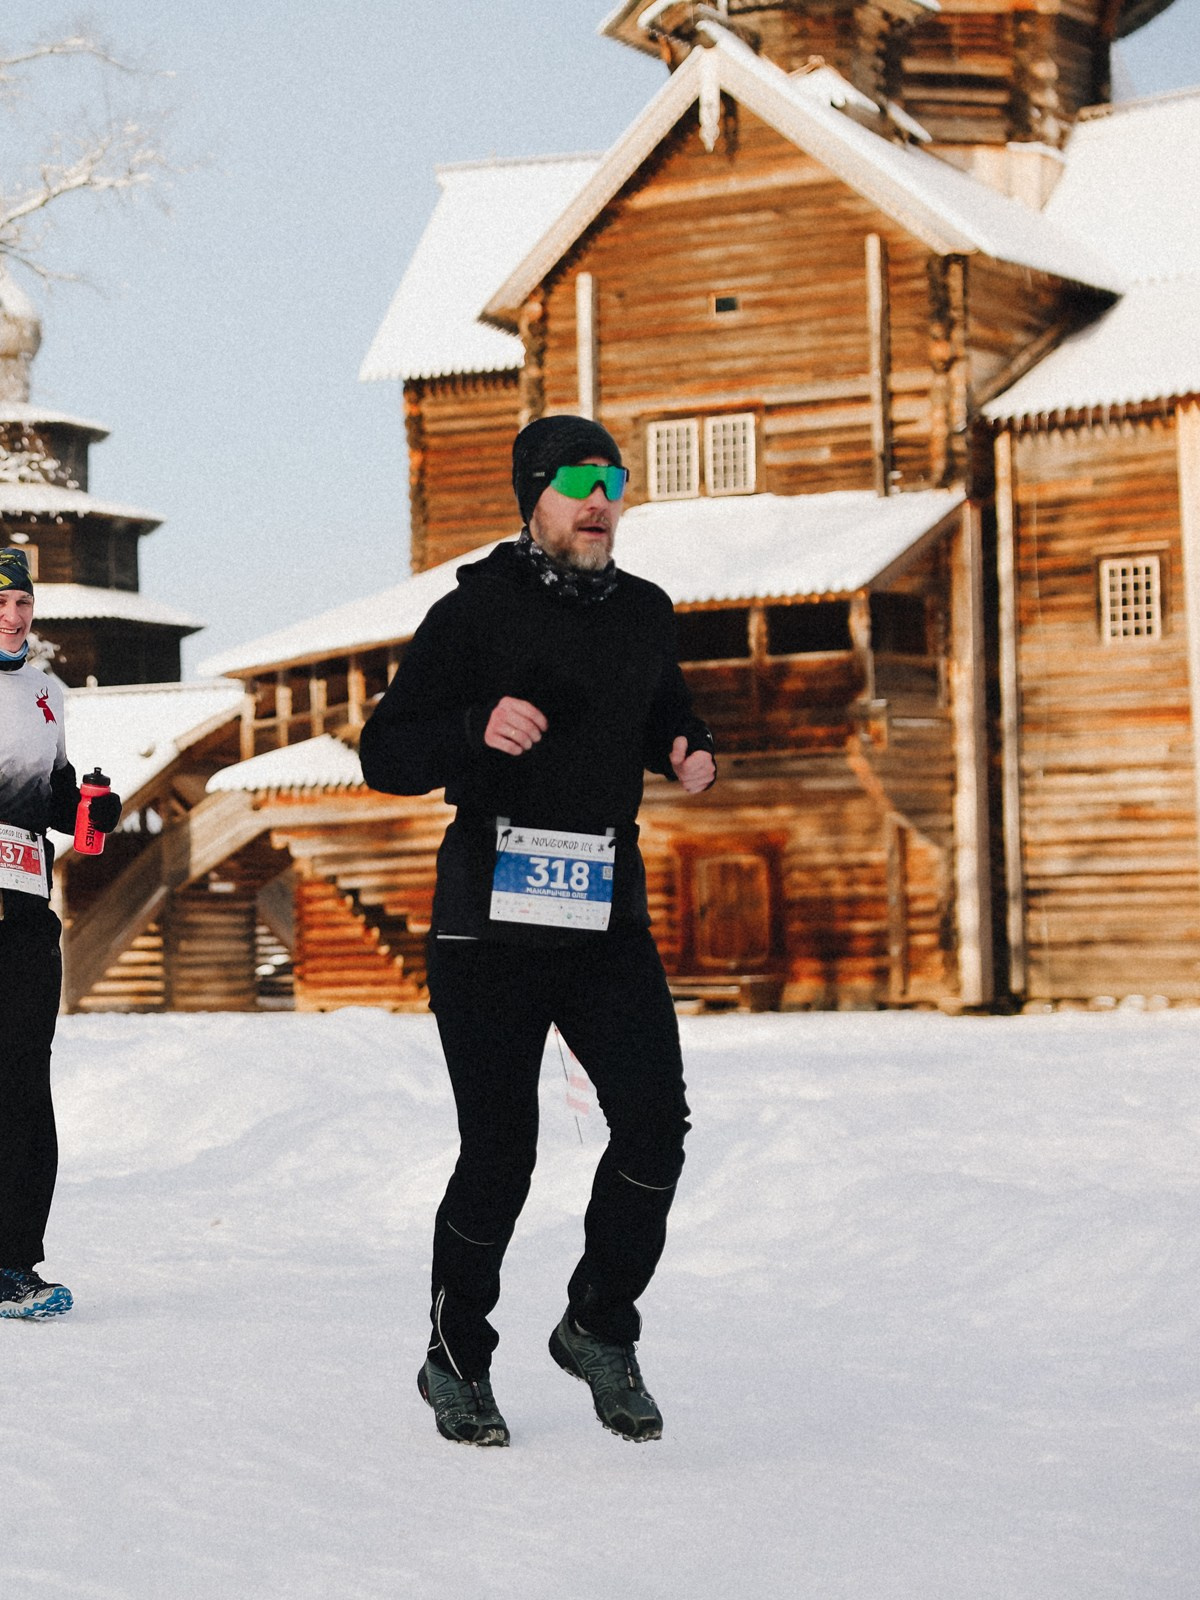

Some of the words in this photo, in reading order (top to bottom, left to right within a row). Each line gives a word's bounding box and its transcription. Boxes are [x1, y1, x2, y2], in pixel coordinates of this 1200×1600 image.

[531, 836, 579, 850] NOVGOROD
[580, 842, 593, 853] ICE
[526, 856, 590, 891] 318
